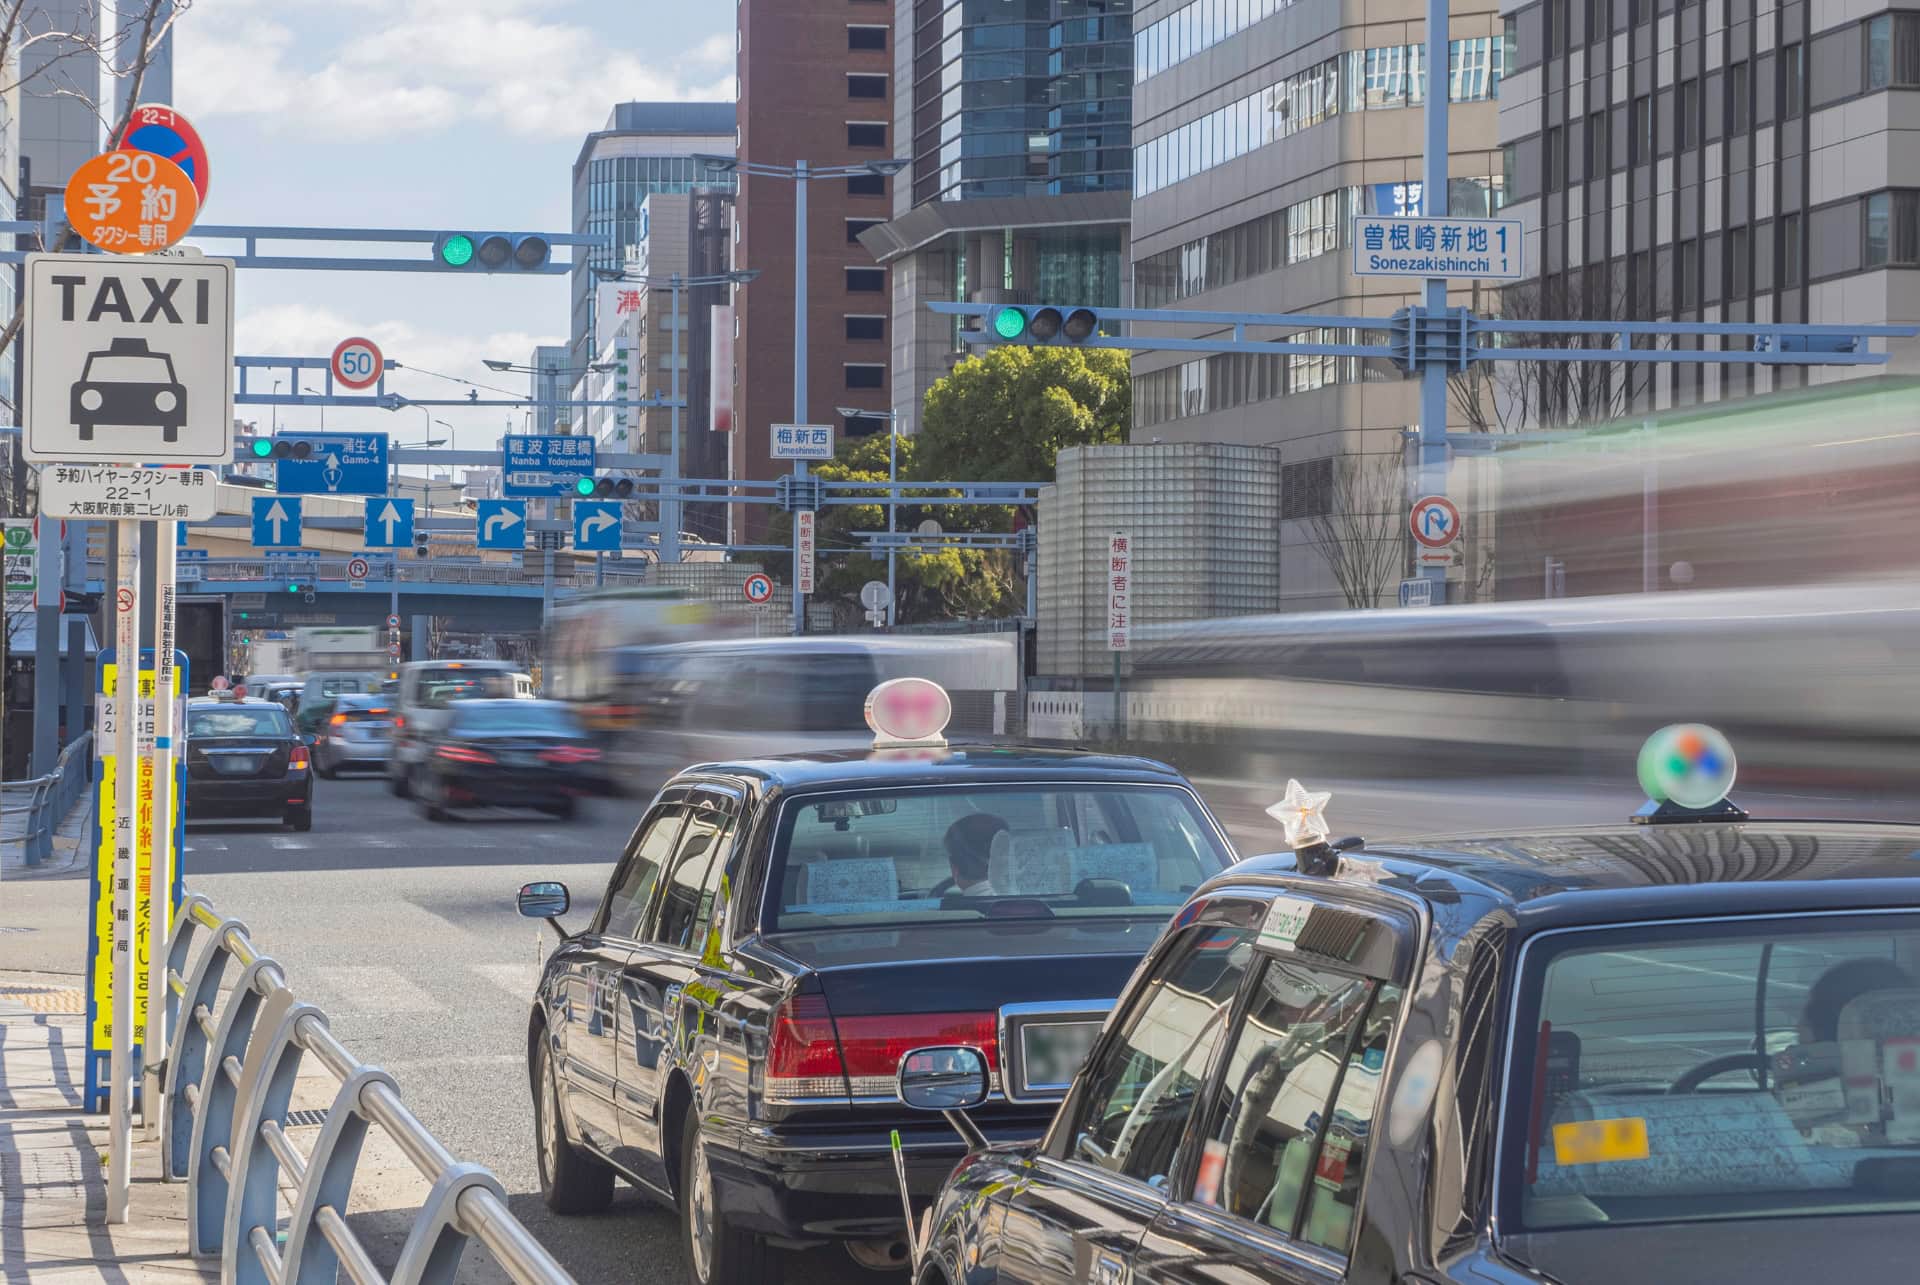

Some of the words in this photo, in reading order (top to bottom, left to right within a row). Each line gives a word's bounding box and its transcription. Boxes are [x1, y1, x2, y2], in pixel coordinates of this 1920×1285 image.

[142, 108, 175, 126] 22-1
[106, 153, 156, 183] 20
[84, 183, 176, 221] 予約
[92, 223, 168, 246] タクシー専用
[1370, 254, 1489, 272] Sonezakishinchi
[1501, 258, 1508, 272] 1
[51, 275, 209, 325] TAXI
[343, 352, 371, 375] 50
[777, 429, 827, 445] 梅新西
[342, 455, 380, 465] Gamo-4
[511, 457, 541, 465] Nanba
[547, 457, 592, 468] Yodoyabashi
[55, 468, 204, 486] 予約ハイヤータクシー専用
[106, 487, 151, 500] 22-1
[69, 502, 189, 518] 大阪駅前第二ビル前
[800, 513, 812, 591] 横断者に注意
[1111, 538, 1128, 648] 横断者に注意
